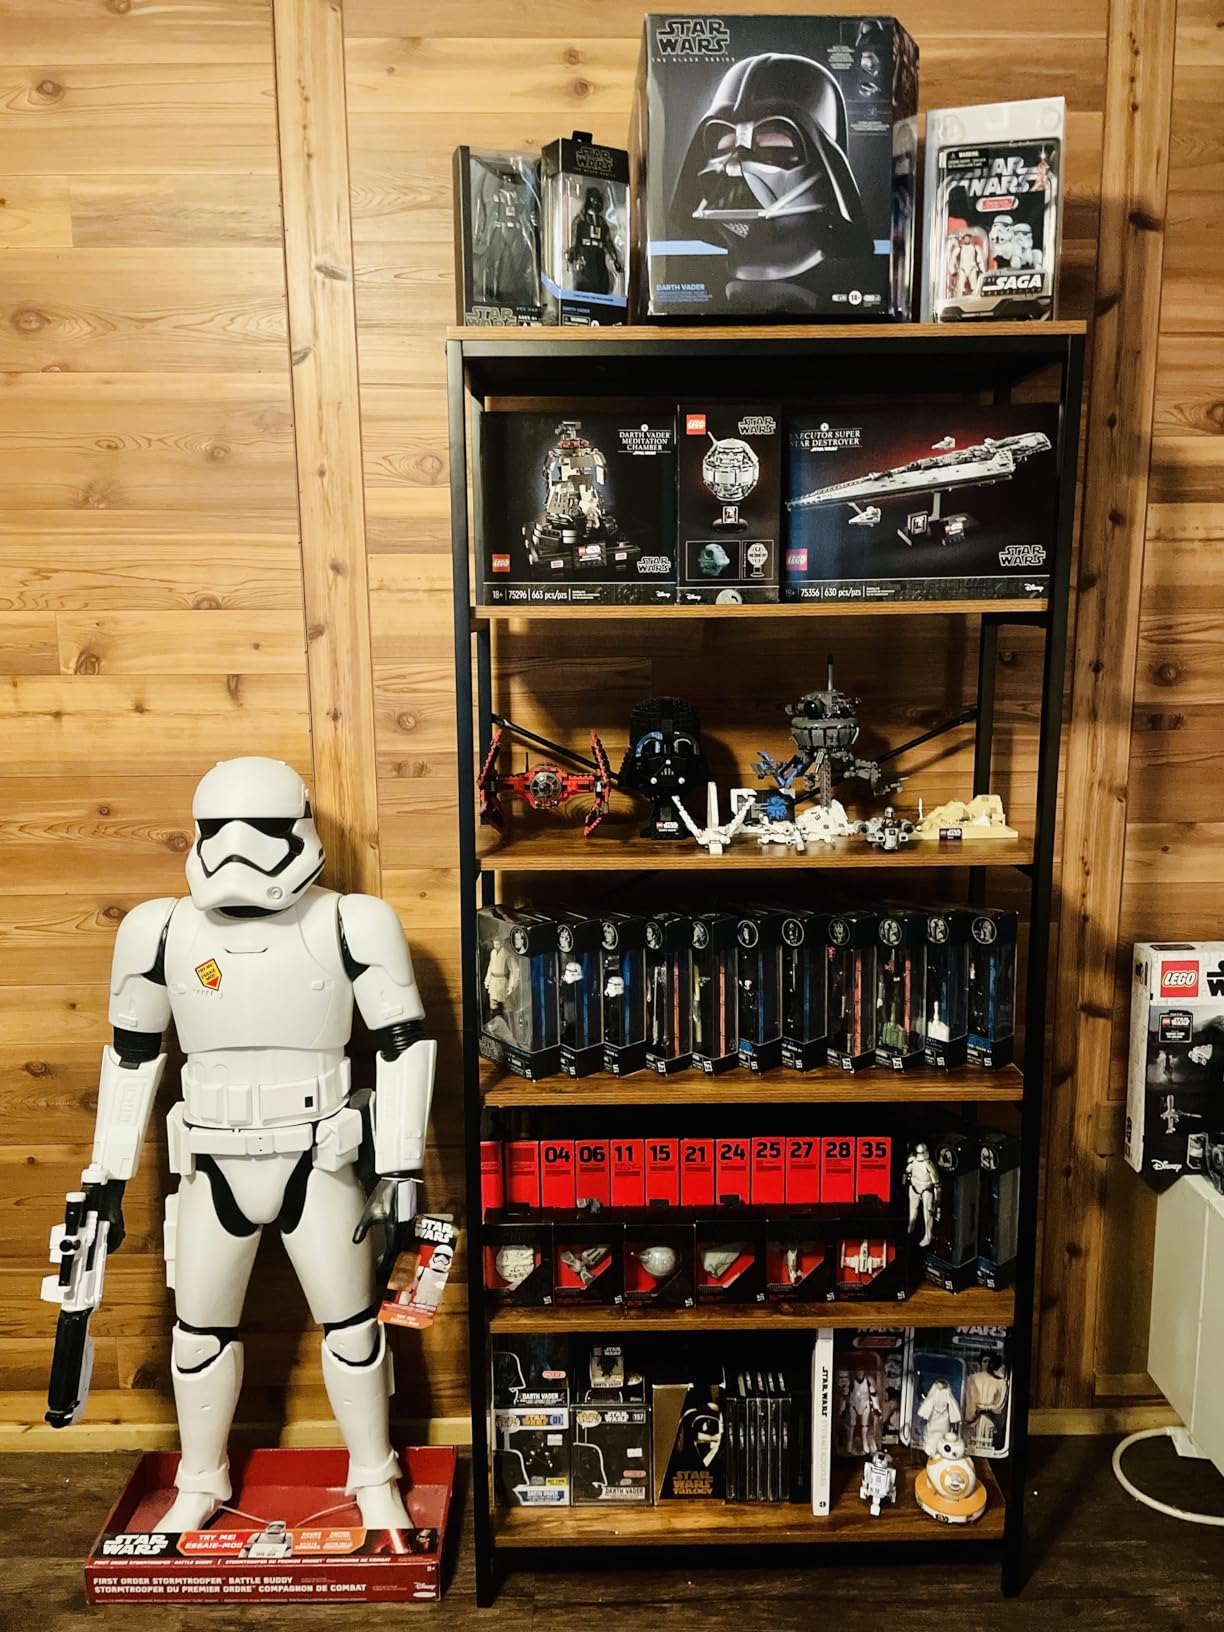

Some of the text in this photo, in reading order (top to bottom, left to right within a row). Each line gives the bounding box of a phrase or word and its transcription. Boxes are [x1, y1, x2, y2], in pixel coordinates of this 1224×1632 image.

[657, 19, 729, 37] STAR
[657, 36, 730, 55] WARS
[576, 146, 612, 162] STAR
[576, 156, 613, 172] WARS
[656, 283, 705, 291] DARTH VADER
[982, 274, 1042, 291] SAGA
[465, 305, 516, 322] STAR
[738, 416, 776, 427] STAR
[619, 431, 670, 439] DARTH VADER
[738, 424, 776, 435] WARS
[834, 430, 861, 439] SUPER
[812, 438, 860, 447] DESTROYER
[999, 545, 1046, 557] STAR
[637, 556, 671, 566] STAR
[787, 554, 806, 565] LEGO
[999, 554, 1046, 567] WARS
[637, 563, 671, 573] WARS
[800, 588, 820, 598] 75356
[824, 587, 837, 597] 630
[838, 587, 862, 598] pcs/pzs
[1023, 583, 1044, 592] Disney
[492, 590, 504, 600] 18+
[508, 590, 528, 600] 75296
[531, 590, 543, 600] 663
[544, 590, 568, 601] pcs/pzs
[655, 590, 671, 598] Disney
[1161, 970, 1198, 988] LEGO
[544, 1145, 571, 1163] 04
[579, 1145, 606, 1163] 06
[614, 1145, 634, 1162] 11
[650, 1145, 671, 1161] 15
[684, 1145, 706, 1162] 21
[720, 1144, 746, 1160] 24
[756, 1141, 781, 1158] 25
[790, 1141, 814, 1158] 27
[825, 1141, 851, 1158] 28
[861, 1141, 887, 1158] 35
[1151, 1159, 1183, 1173] Disney
[416, 1218, 453, 1234] STAR
[415, 1227, 454, 1243] WARS
[522, 1392, 559, 1400] DARTH VADER
[604, 1415, 629, 1423] WARS
[605, 1410, 628, 1418] STAR
[673, 1471, 713, 1480] STAR
[673, 1478, 713, 1488] WARS
[606, 1488, 644, 1496] DARTH VADER
[673, 1487, 713, 1495] TRILOGY
[105, 1534, 168, 1546] STAR
[103, 1543, 167, 1555] WARS
[93, 1577, 117, 1585] FIRST
[120, 1577, 149, 1585] ORDER
[152, 1577, 222, 1585] STORMTROOPER
[228, 1577, 260, 1585] BATTLE
[263, 1576, 293, 1584] BUDDY
[330, 1584, 367, 1592] COMBAT
